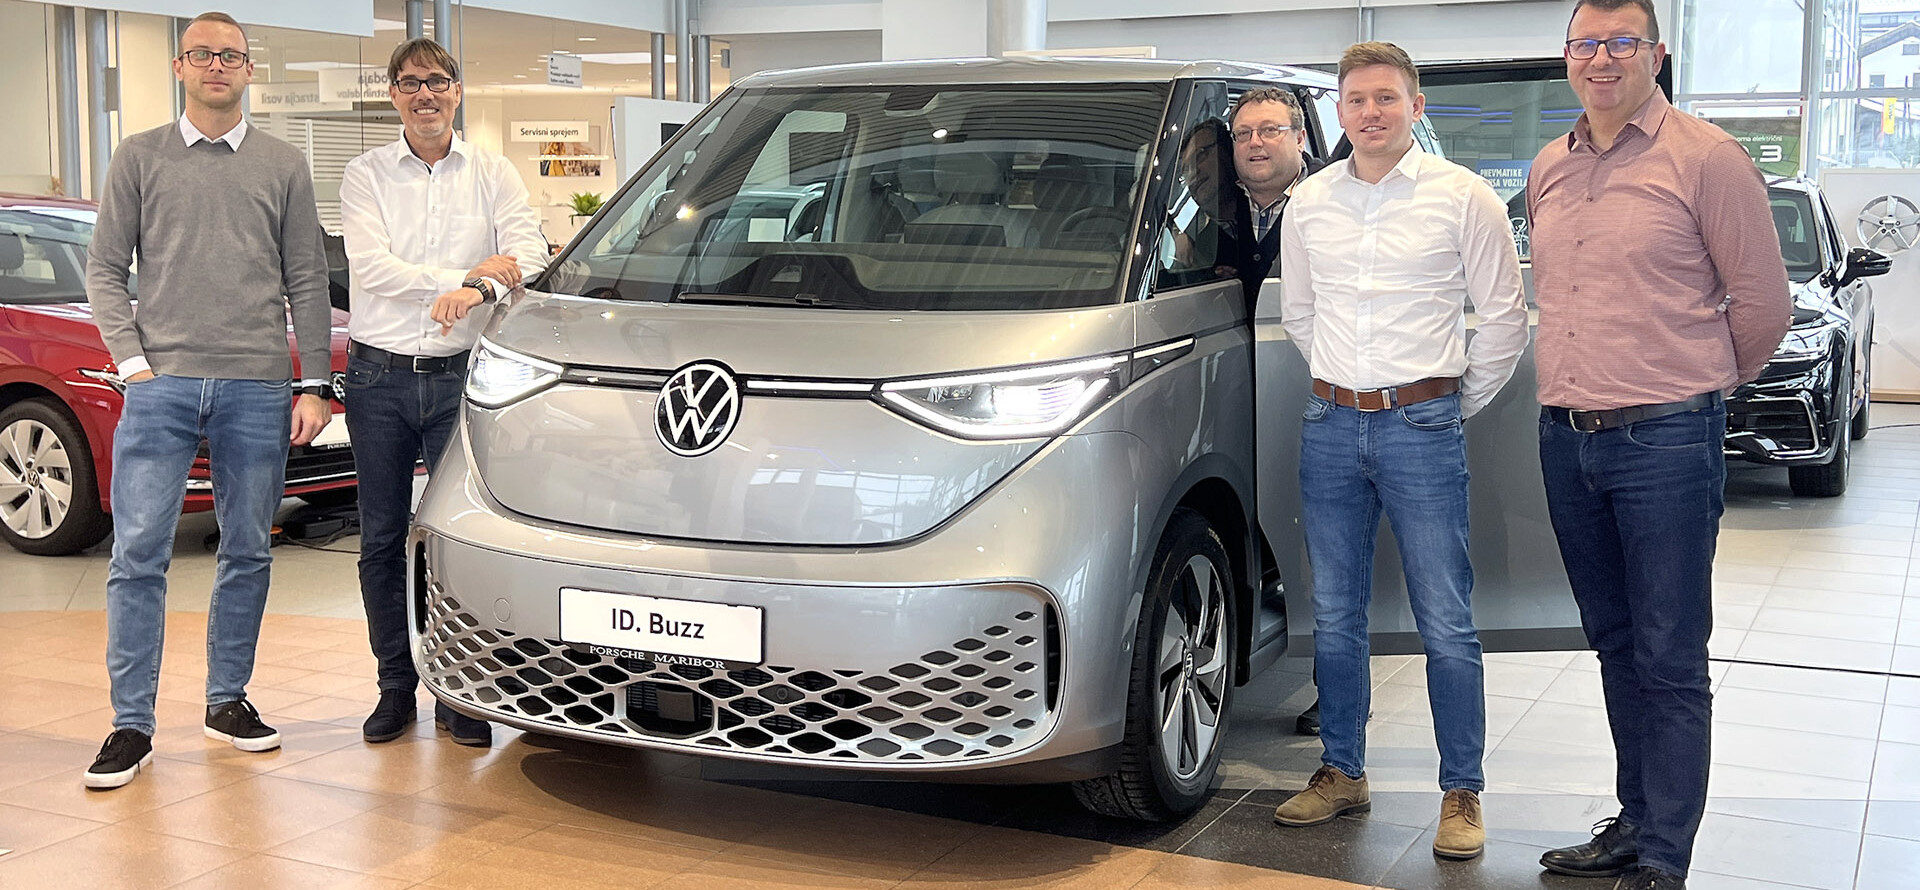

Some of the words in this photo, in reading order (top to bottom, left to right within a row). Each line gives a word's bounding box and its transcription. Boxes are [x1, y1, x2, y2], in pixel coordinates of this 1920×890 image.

[520, 127, 549, 136] Servisni
[550, 127, 579, 138] sprejem
[1480, 168, 1523, 178] PNEVMATIKE
[611, 608, 642, 633] ID.
[649, 612, 705, 640] Buzz
[589, 645, 646, 661] PORSCHE
[653, 653, 726, 670] MARIBOR
